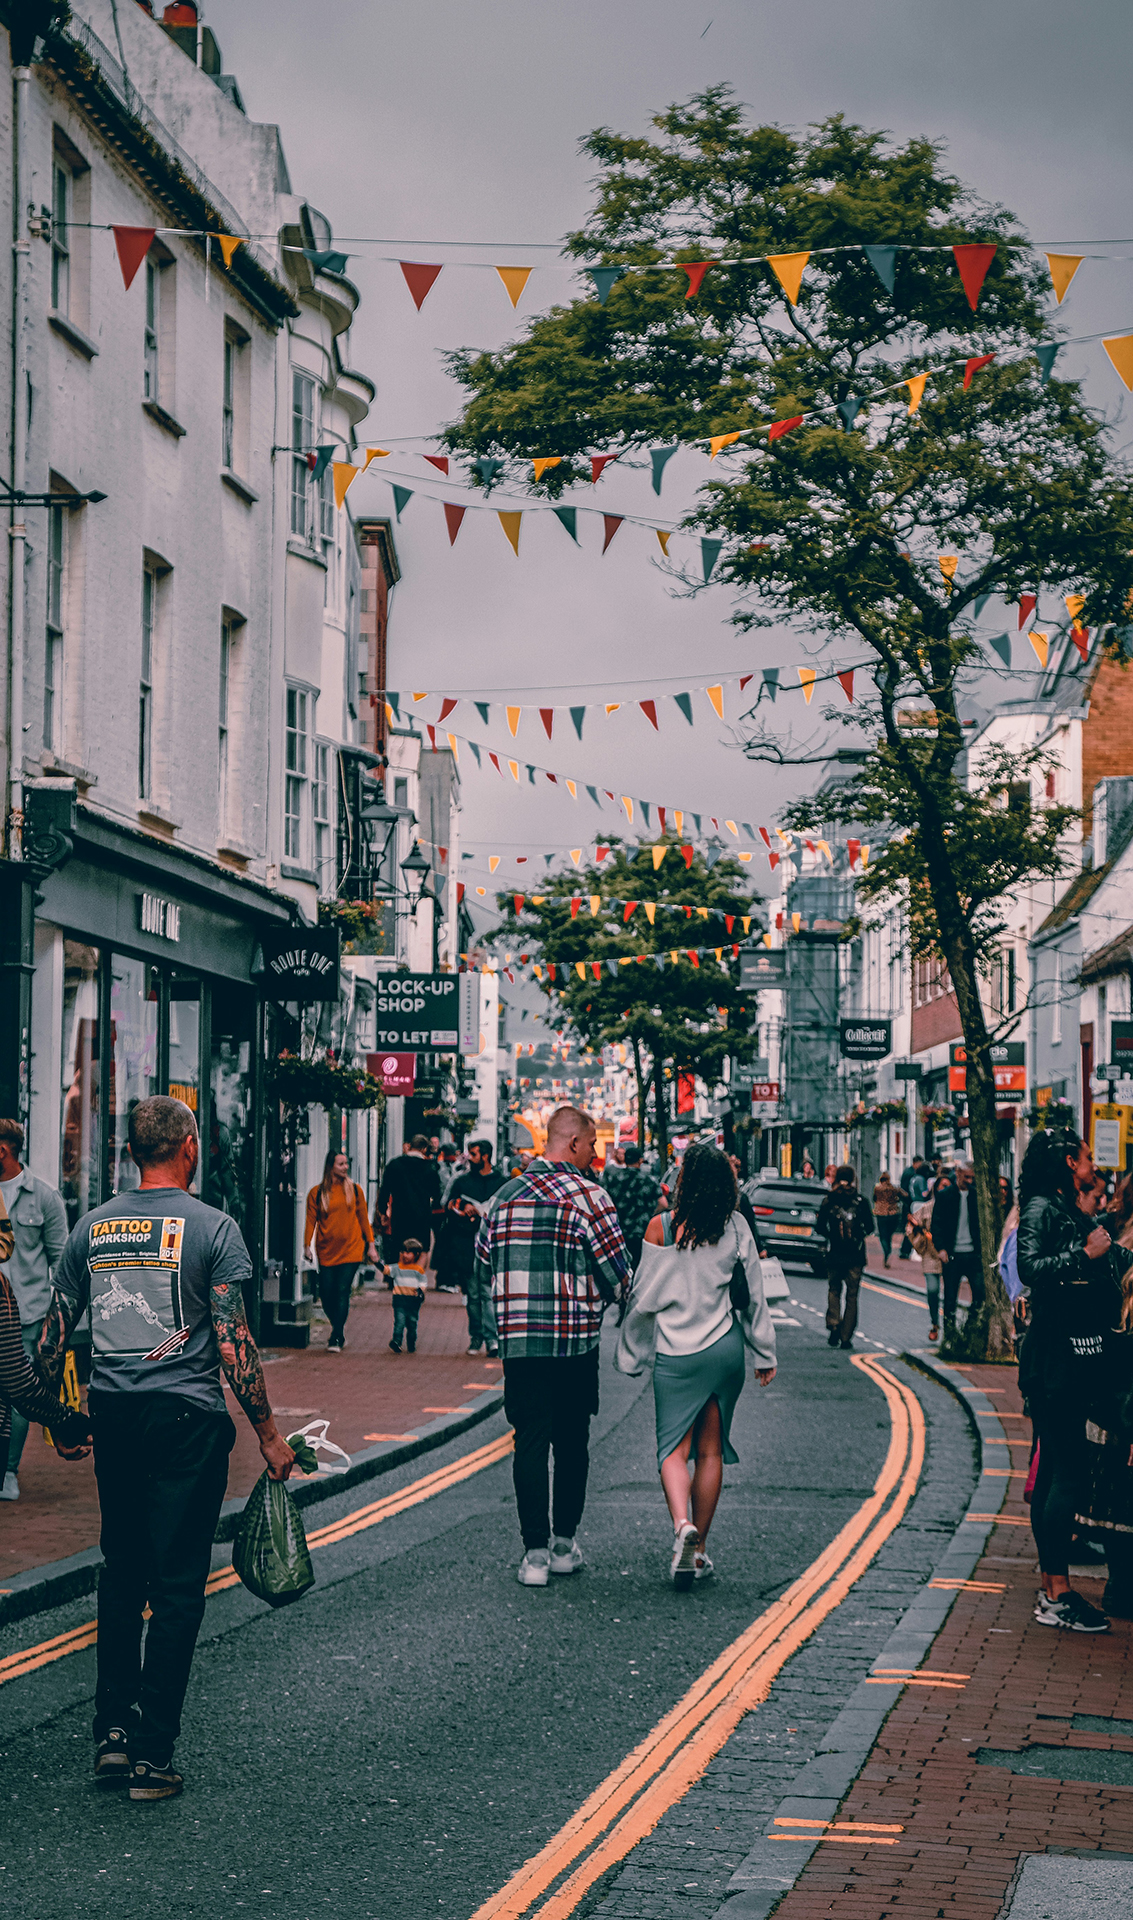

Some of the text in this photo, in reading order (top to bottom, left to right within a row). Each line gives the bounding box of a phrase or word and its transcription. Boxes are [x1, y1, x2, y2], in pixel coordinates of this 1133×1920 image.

[270, 949, 334, 975] ROUTE ONE
[378, 979, 455, 995] LOCK-UP
[378, 997, 425, 1013] SHOP
[378, 1030, 399, 1043] TO
[402, 1031, 429, 1044] LET
[92, 1220, 153, 1236] TATTOO
[91, 1233, 151, 1247] WORKSHOP
[161, 1250, 180, 1258] 2011
[161, 1261, 177, 1269] shop
